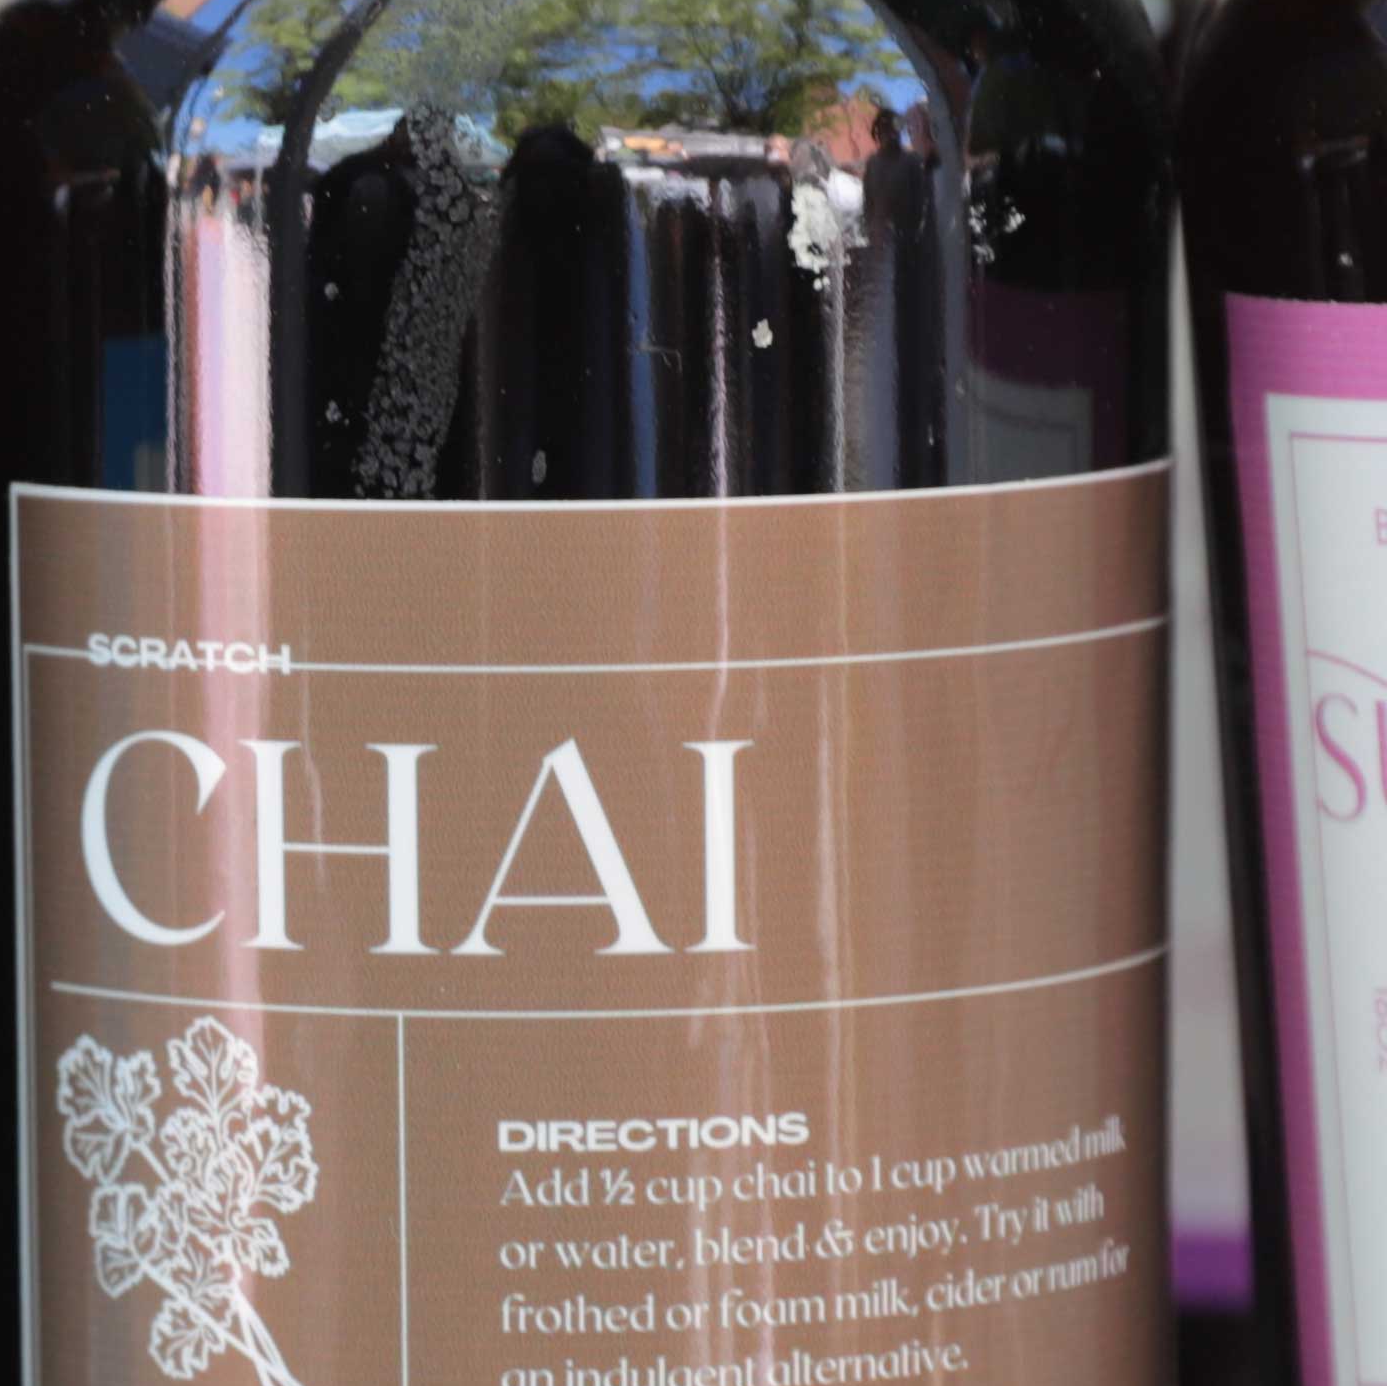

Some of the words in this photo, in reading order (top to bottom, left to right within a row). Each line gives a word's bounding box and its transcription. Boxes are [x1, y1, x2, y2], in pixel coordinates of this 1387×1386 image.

[86, 633, 291, 676] SCRATCH
[80, 728, 757, 957] CHAI
[497, 1111, 810, 1153] DIRECTIONS
[499, 1166, 591, 1207] Add
[645, 1174, 724, 1212] cup
[732, 1160, 816, 1202] chai
[826, 1160, 863, 1196] to
[891, 1155, 956, 1194] cup
[962, 1124, 1080, 1180] warmed
[1084, 1114, 1126, 1160] milk
[499, 1239, 544, 1270] or
[555, 1234, 684, 1271] water,
[695, 1222, 805, 1267] blend
[815, 1217, 855, 1260] &
[864, 1213, 968, 1258] enjoy.
[974, 1202, 1027, 1245] Try
[1033, 1196, 1049, 1233] it
[1054, 1182, 1105, 1226] with
[501, 1292, 655, 1334] frothed
[666, 1301, 710, 1331] or
[720, 1288, 826, 1330] foam
[835, 1277, 919, 1321] milk,
[926, 1268, 1006, 1312] cider
[1011, 1267, 1044, 1301] or
[1047, 1255, 1098, 1292] rum
[1099, 1237, 1130, 1279] for
